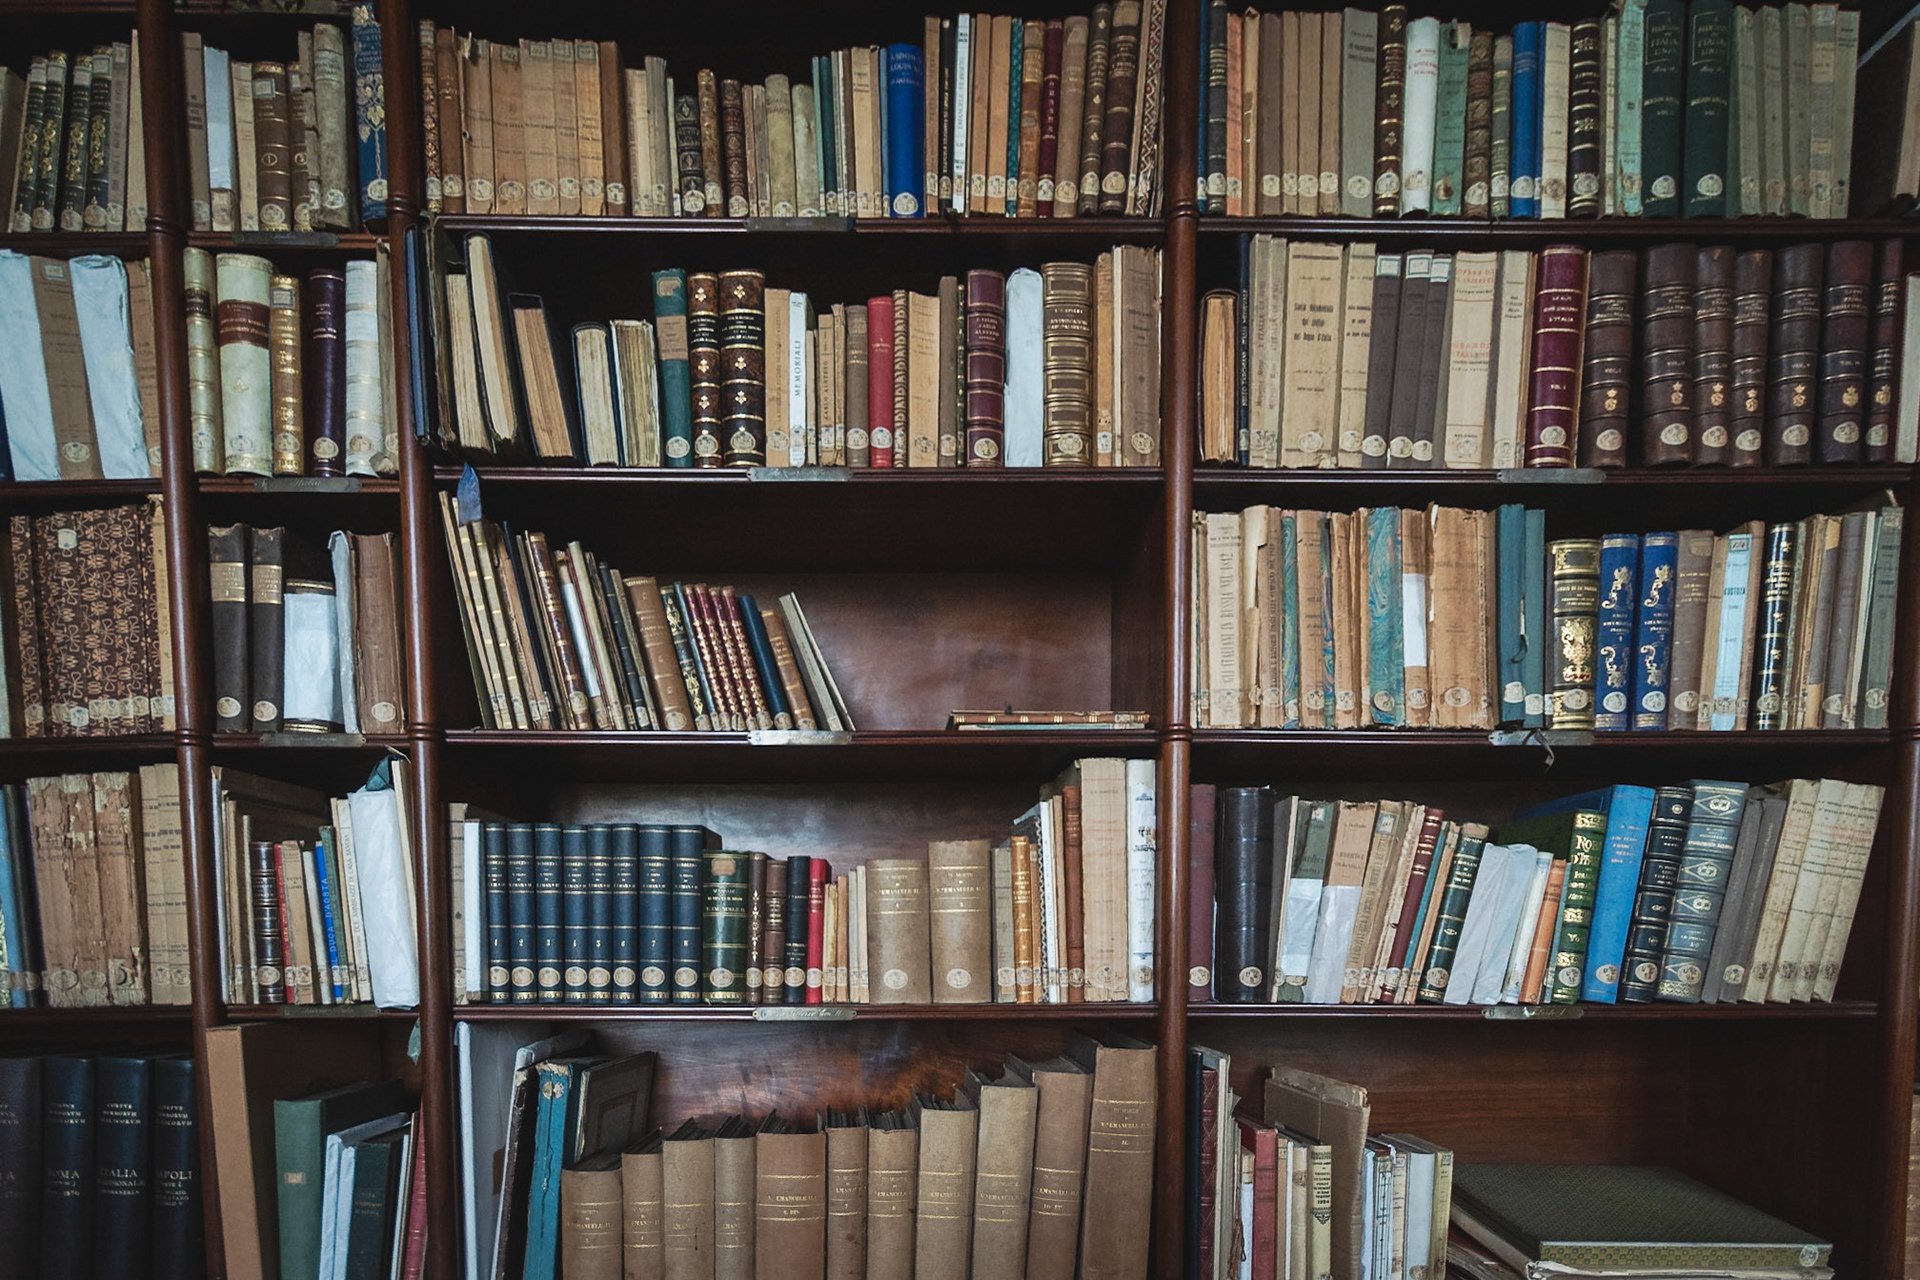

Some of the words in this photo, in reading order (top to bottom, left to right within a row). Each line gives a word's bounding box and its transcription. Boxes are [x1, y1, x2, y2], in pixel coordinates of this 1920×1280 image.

[1220, 592, 1234, 618] RUSSIA
[1220, 622, 1234, 630] IN
[1220, 634, 1235, 666] ITALIANI
[321, 878, 332, 918] D'AOSTA
[327, 926, 336, 952] DUCA
[99, 1168, 138, 1179] ITALIA
